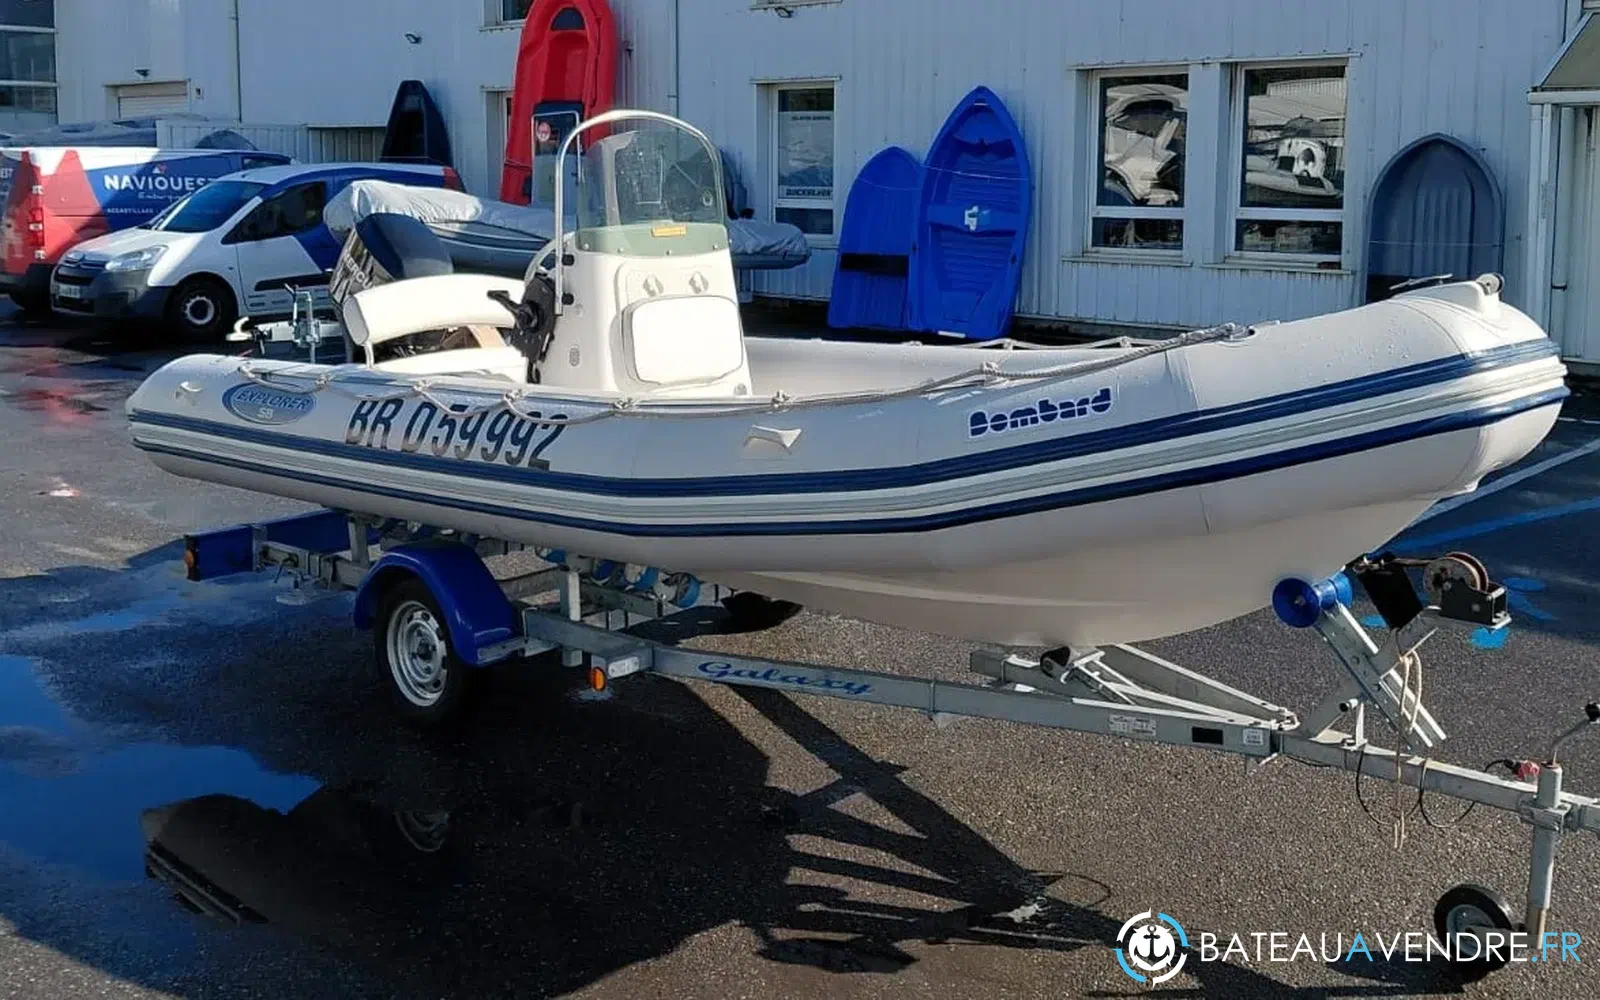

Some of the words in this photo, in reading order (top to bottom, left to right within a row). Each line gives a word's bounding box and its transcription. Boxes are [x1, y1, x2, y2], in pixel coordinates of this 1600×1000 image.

[235, 390, 311, 411] EXPLORER
[970, 388, 1112, 437] Bombard
[345, 398, 405, 450] BR
[698, 661, 875, 695] Galaxy
